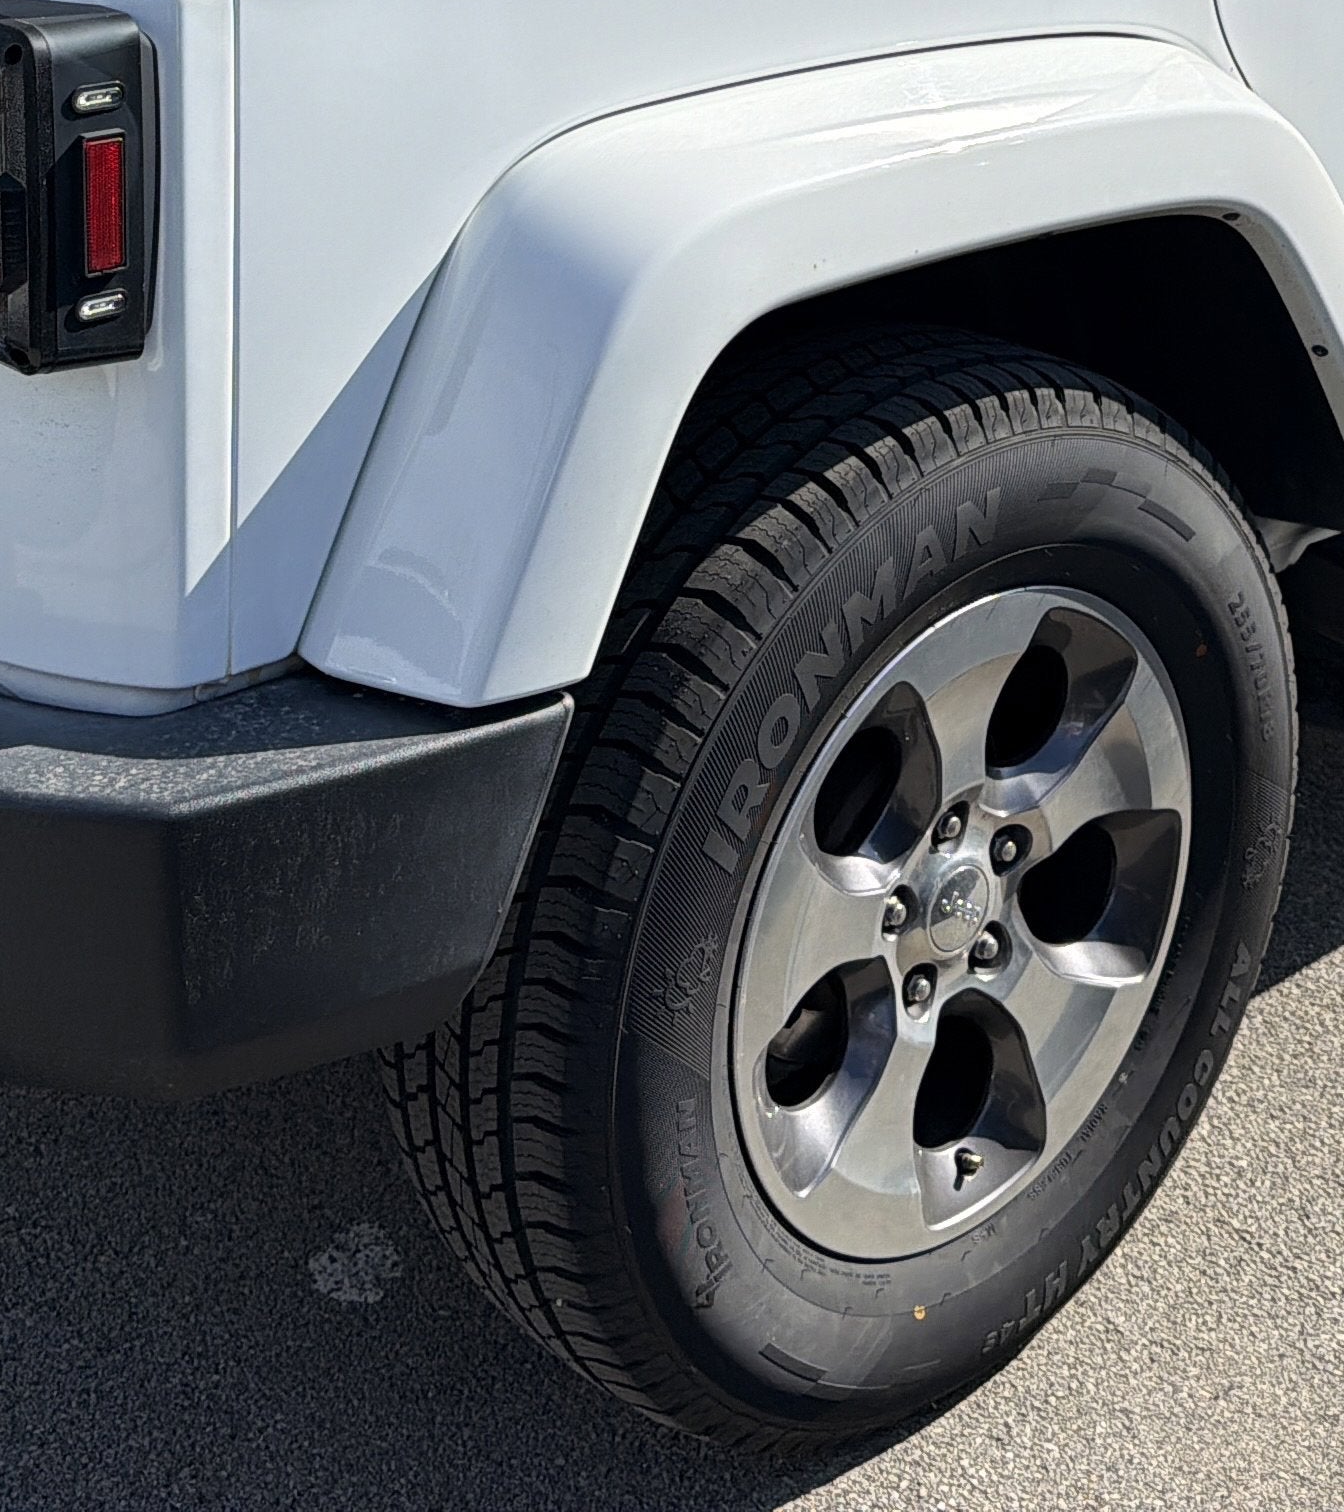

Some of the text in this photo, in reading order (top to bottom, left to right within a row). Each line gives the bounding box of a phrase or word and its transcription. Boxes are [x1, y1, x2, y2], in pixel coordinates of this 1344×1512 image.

[701, 486, 1002, 875] IRONMAN
[1209, 941, 1252, 1037] ALL
[1076, 1048, 1215, 1280] COUNTRY
[1019, 1259, 1068, 1332] HT
